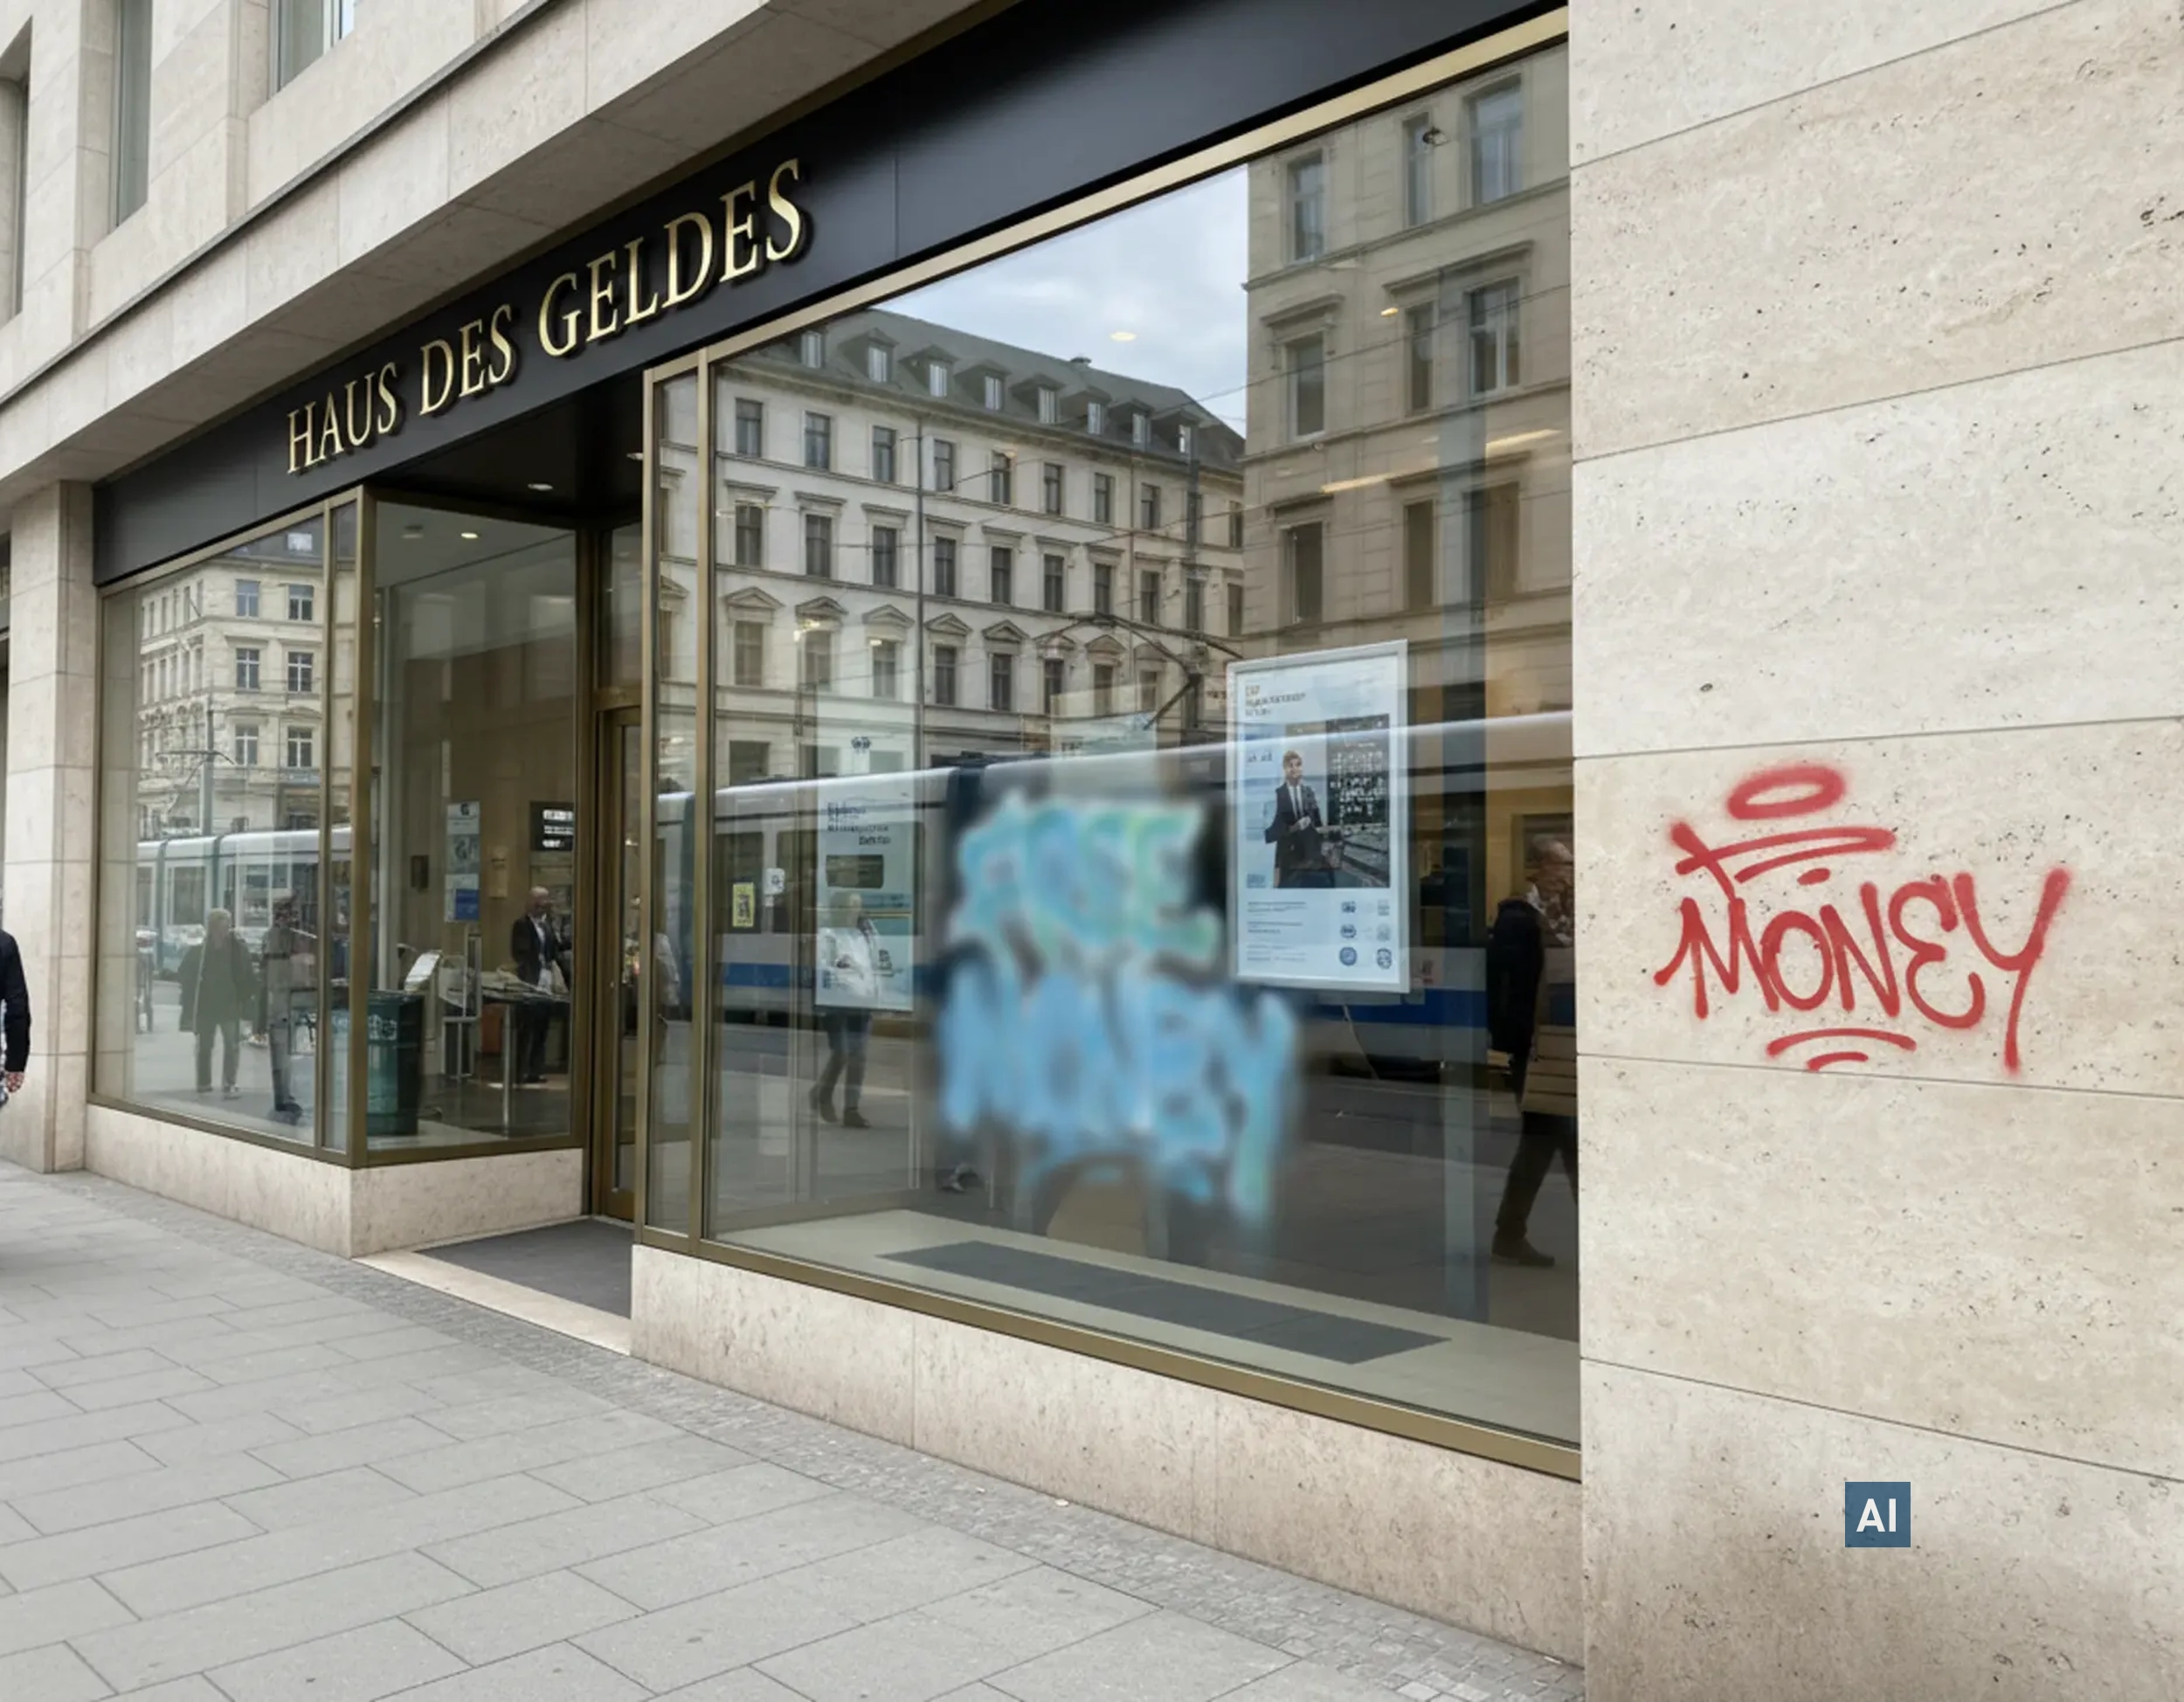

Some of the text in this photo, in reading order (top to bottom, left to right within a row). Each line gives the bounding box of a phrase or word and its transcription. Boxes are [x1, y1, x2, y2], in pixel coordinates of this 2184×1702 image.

[287, 157, 800, 475] HAUS DES GELDES
[1653, 867, 2072, 1076] MONEY
